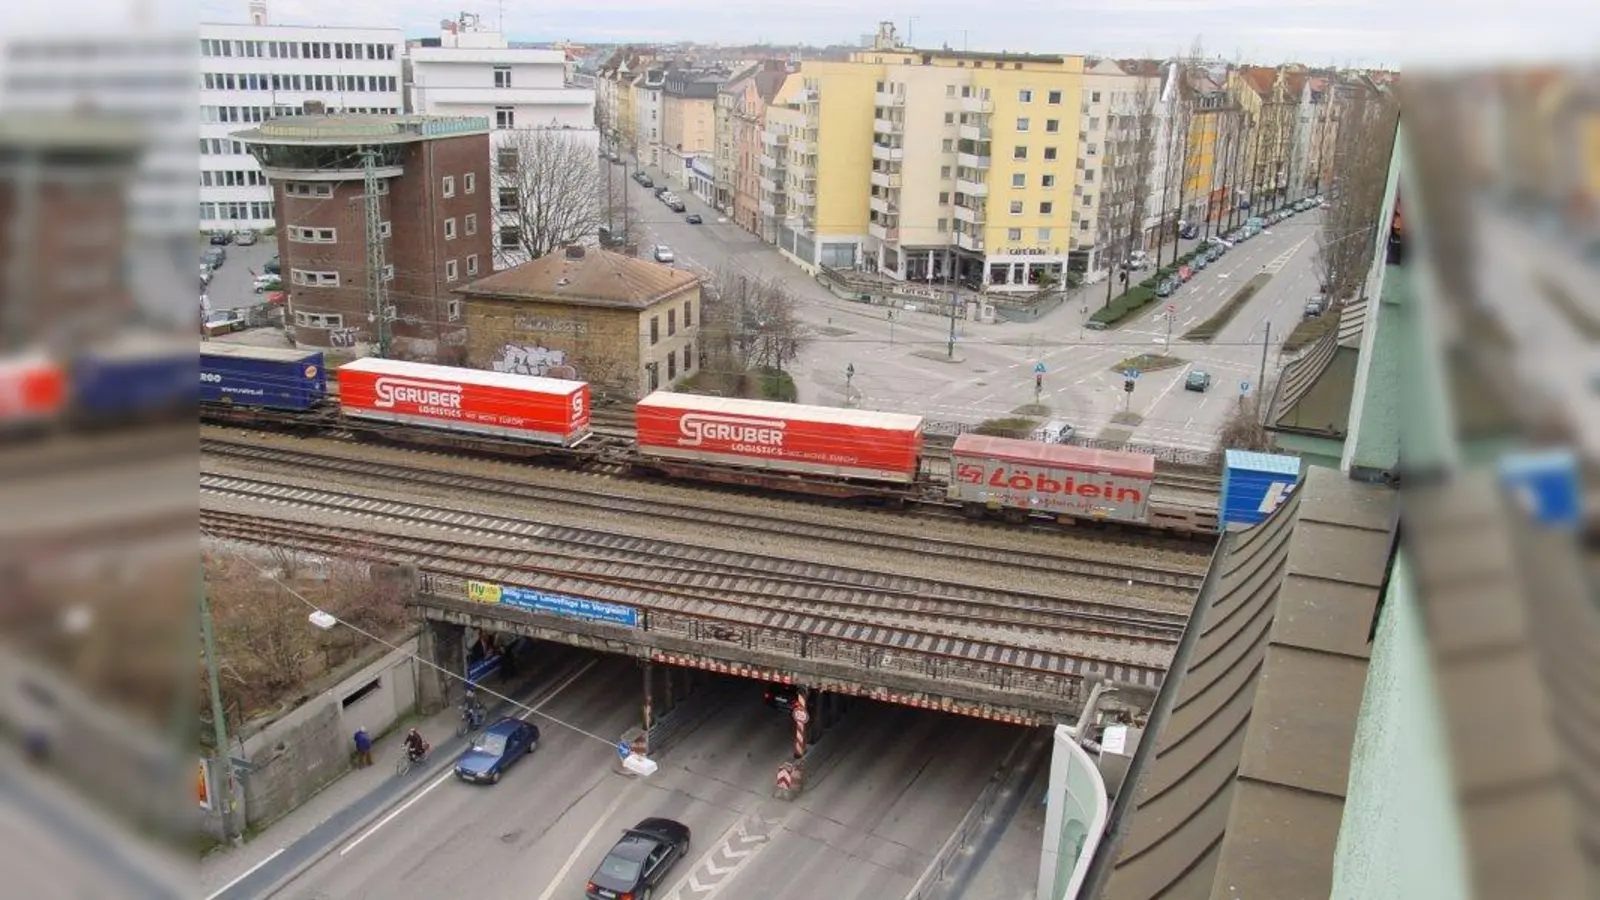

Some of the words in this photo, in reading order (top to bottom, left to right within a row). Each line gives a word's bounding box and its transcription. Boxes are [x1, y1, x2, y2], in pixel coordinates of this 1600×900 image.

[394, 387, 461, 408] GRUBER
[418, 405, 462, 418] LOGISTICS
[703, 423, 783, 445] GRUBER
[731, 443, 783, 456] LOGISTICS
[988, 467, 1144, 504] Löblein
